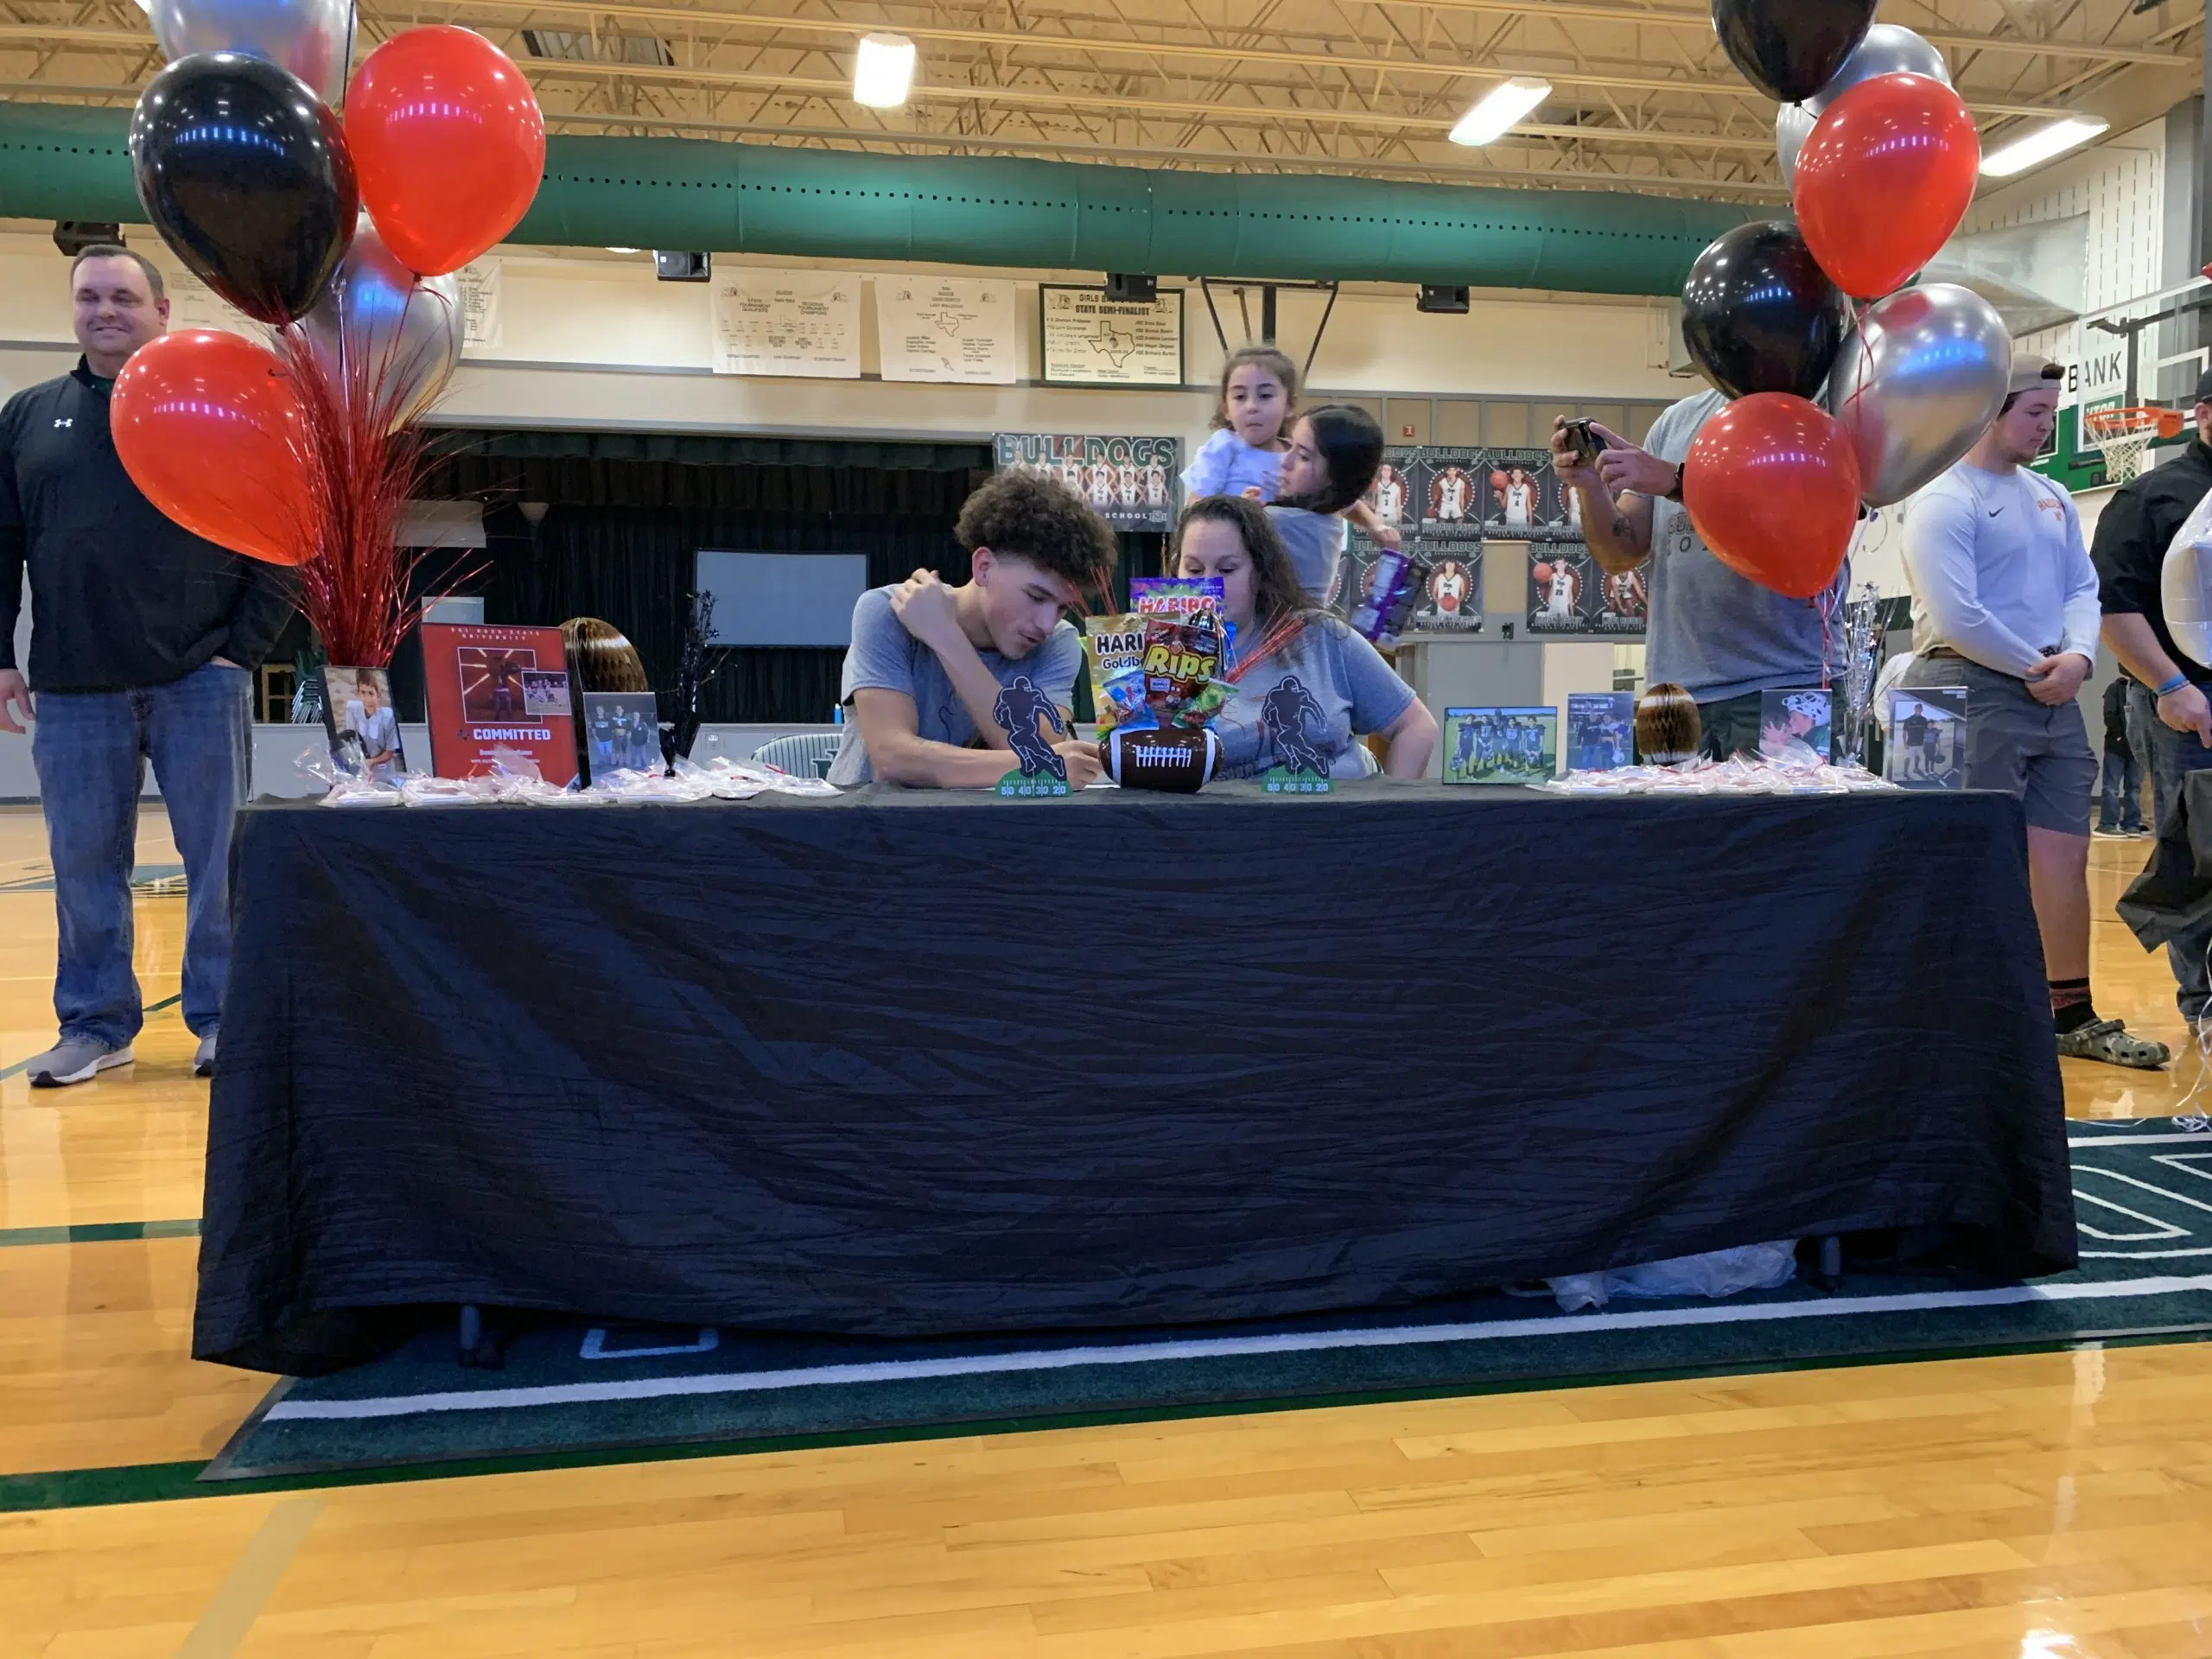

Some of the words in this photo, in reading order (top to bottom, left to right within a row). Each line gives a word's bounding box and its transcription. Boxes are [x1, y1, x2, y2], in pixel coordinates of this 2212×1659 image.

[1078, 294, 1099, 302] GIRLS
[1075, 304, 1096, 314] STATE
[1098, 306, 1149, 316] SEMI-FINALIST
[2069, 351, 2121, 393] BANK
[998, 435, 1174, 469] BULLDOGS
[1484, 449, 1550, 461] BULLDOGS
[1419, 541, 1483, 552] BULLDOGS
[1139, 595, 1217, 615] HARIBO
[1096, 633, 1145, 654] HARI
[1103, 658, 1145, 671] Goldb
[1144, 645, 1216, 684] Rips
[473, 728, 551, 741] COMMITTED
[1001, 785, 1014, 796] 50
[1018, 785, 1032, 796] 40
[1035, 785, 1049, 796] 30
[1052, 785, 1066, 796] 20
[1267, 784, 1281, 792] 50
[1283, 784, 1296, 792] 40
[1300, 784, 1313, 792] 30
[1315, 784, 1329, 792] 20
